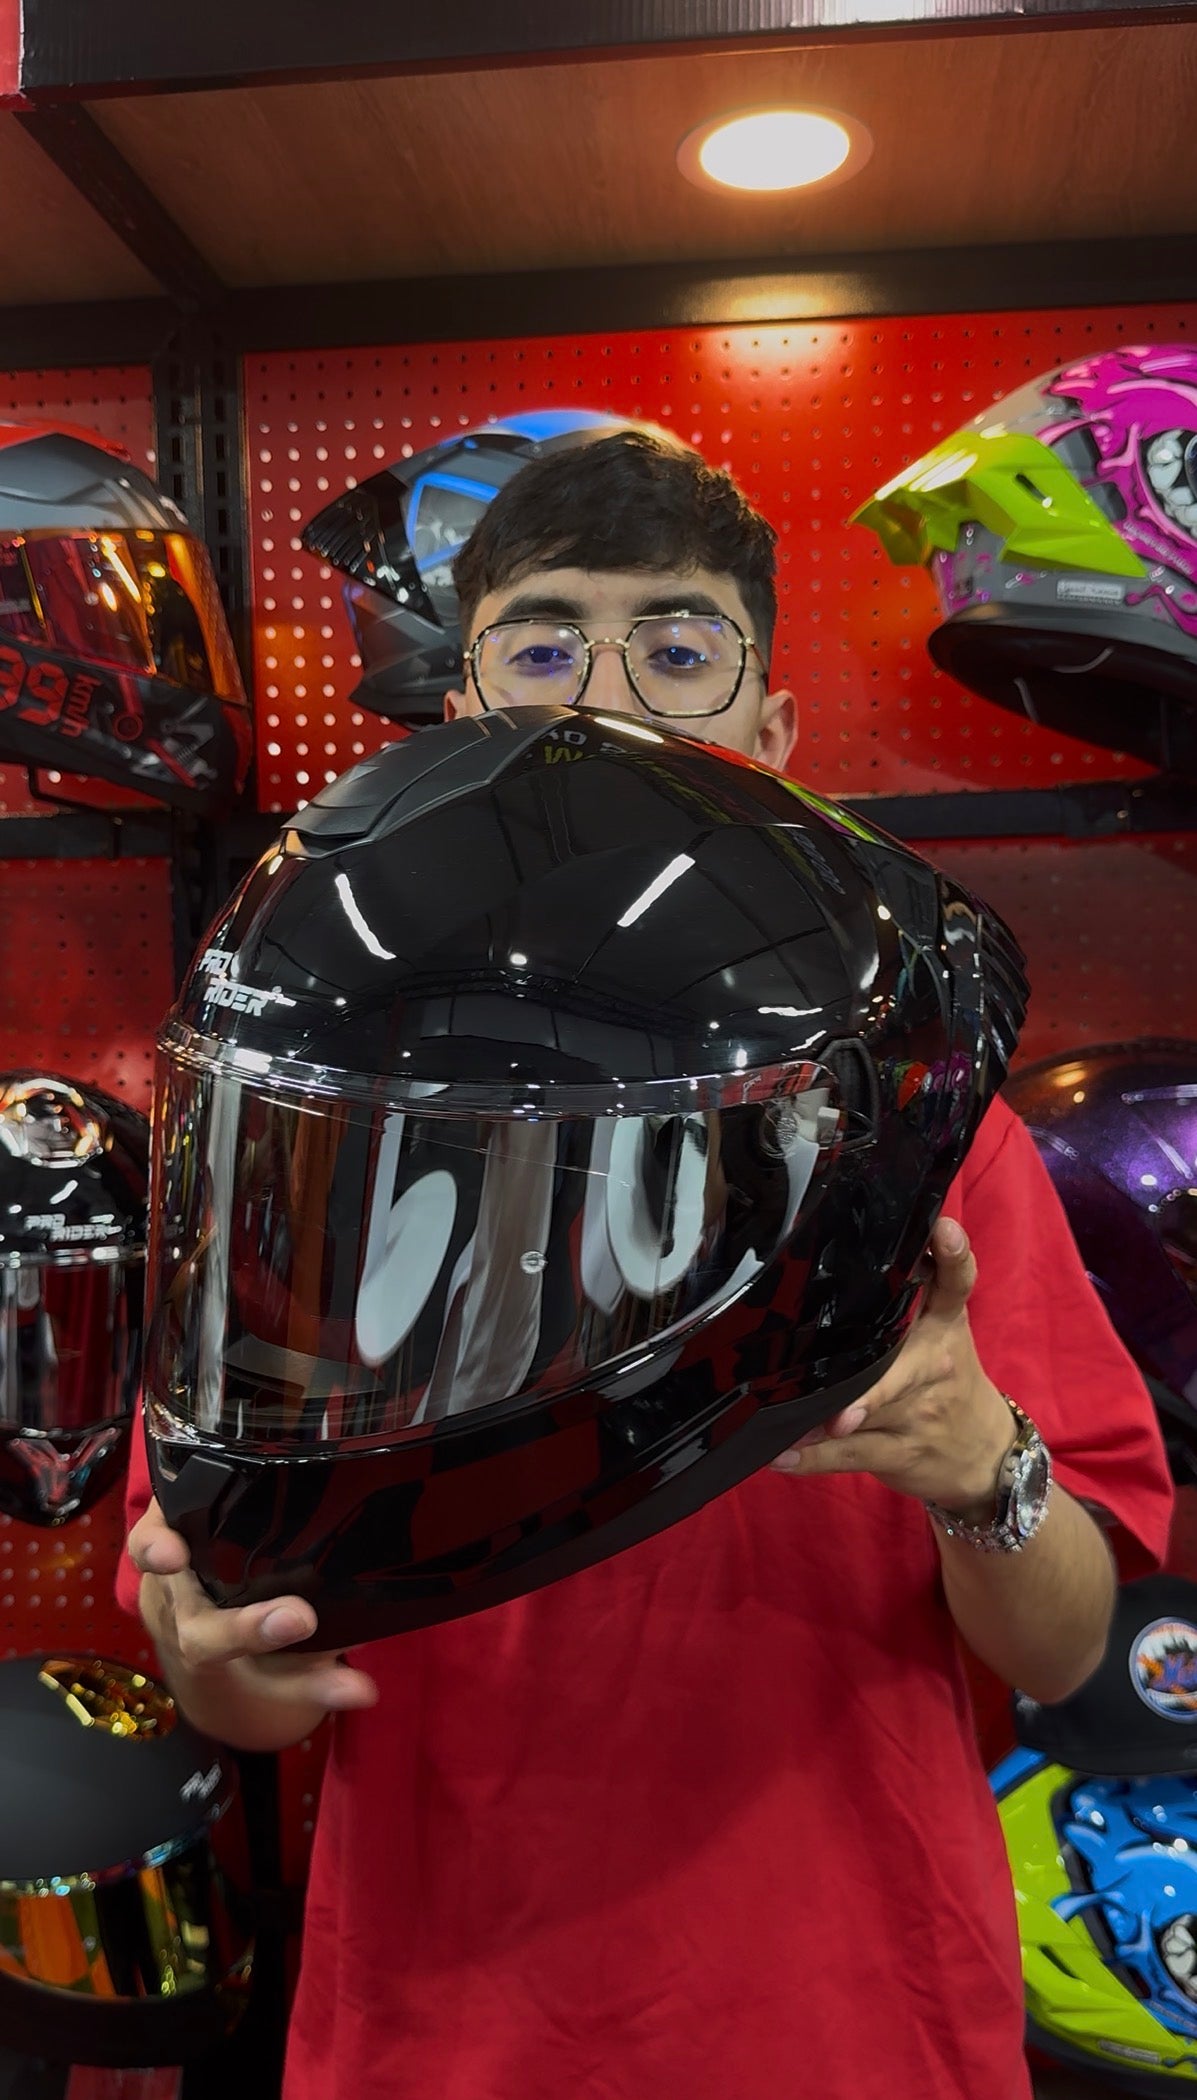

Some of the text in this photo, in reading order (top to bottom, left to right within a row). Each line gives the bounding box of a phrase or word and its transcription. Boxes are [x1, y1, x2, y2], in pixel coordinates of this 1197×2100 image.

[203, 977, 270, 1017] RIDER
[24, 1213, 65, 1231] PRO
[49, 1224, 107, 1241] RIDER
